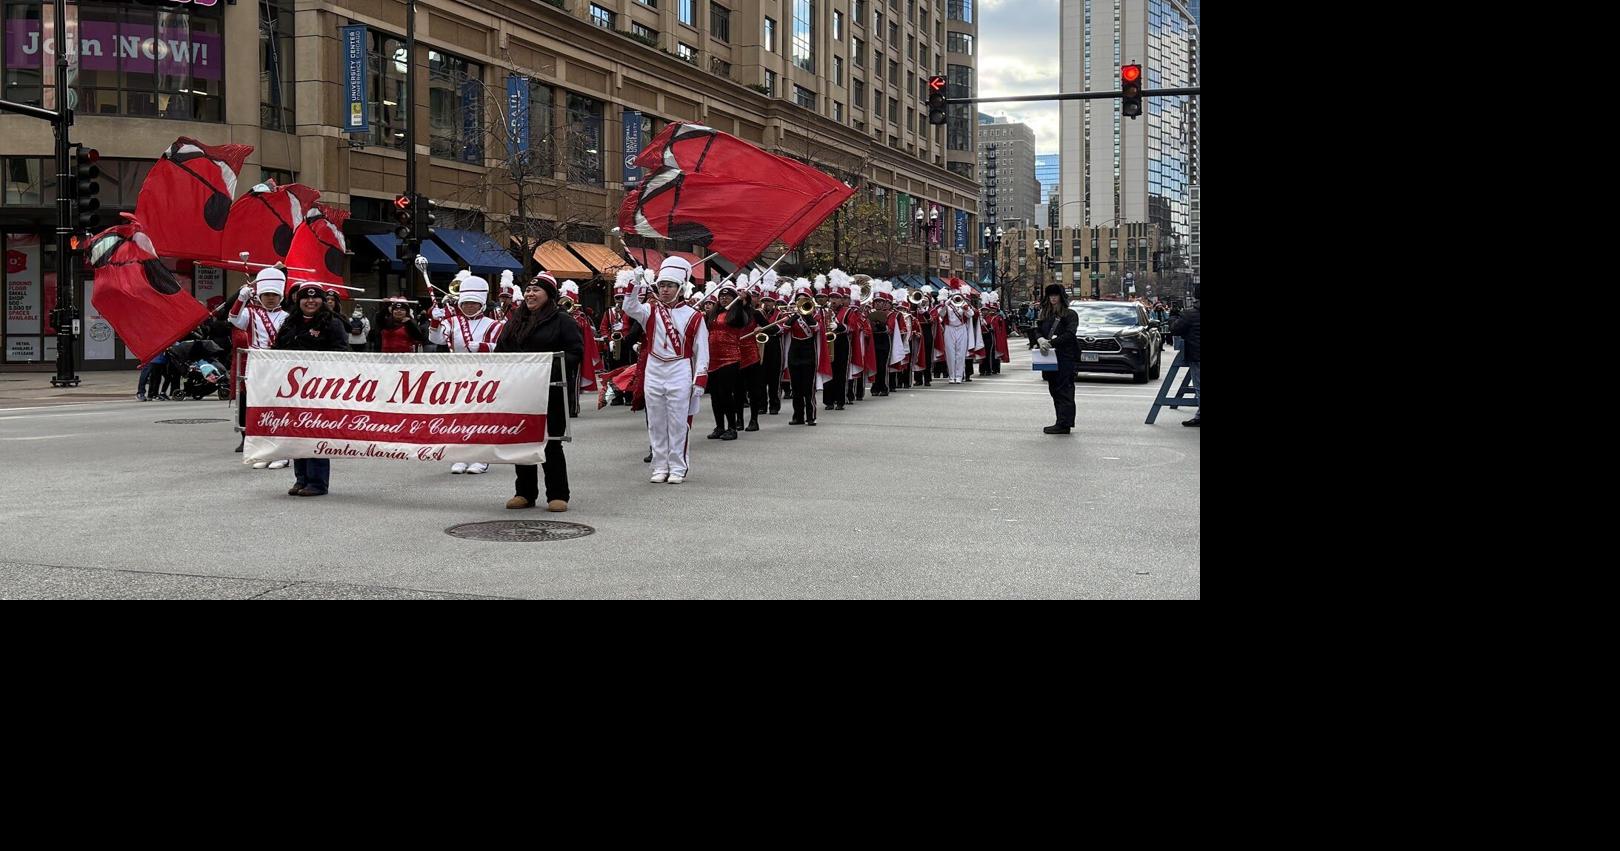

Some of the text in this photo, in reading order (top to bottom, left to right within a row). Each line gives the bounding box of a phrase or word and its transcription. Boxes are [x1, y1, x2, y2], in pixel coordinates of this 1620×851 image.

[22, 31, 209, 66] Join NOW!
[276, 366, 501, 405] Santa Maria
[257, 410, 526, 441] High School Band & Colorguard
[314, 440, 360, 457] Santa
